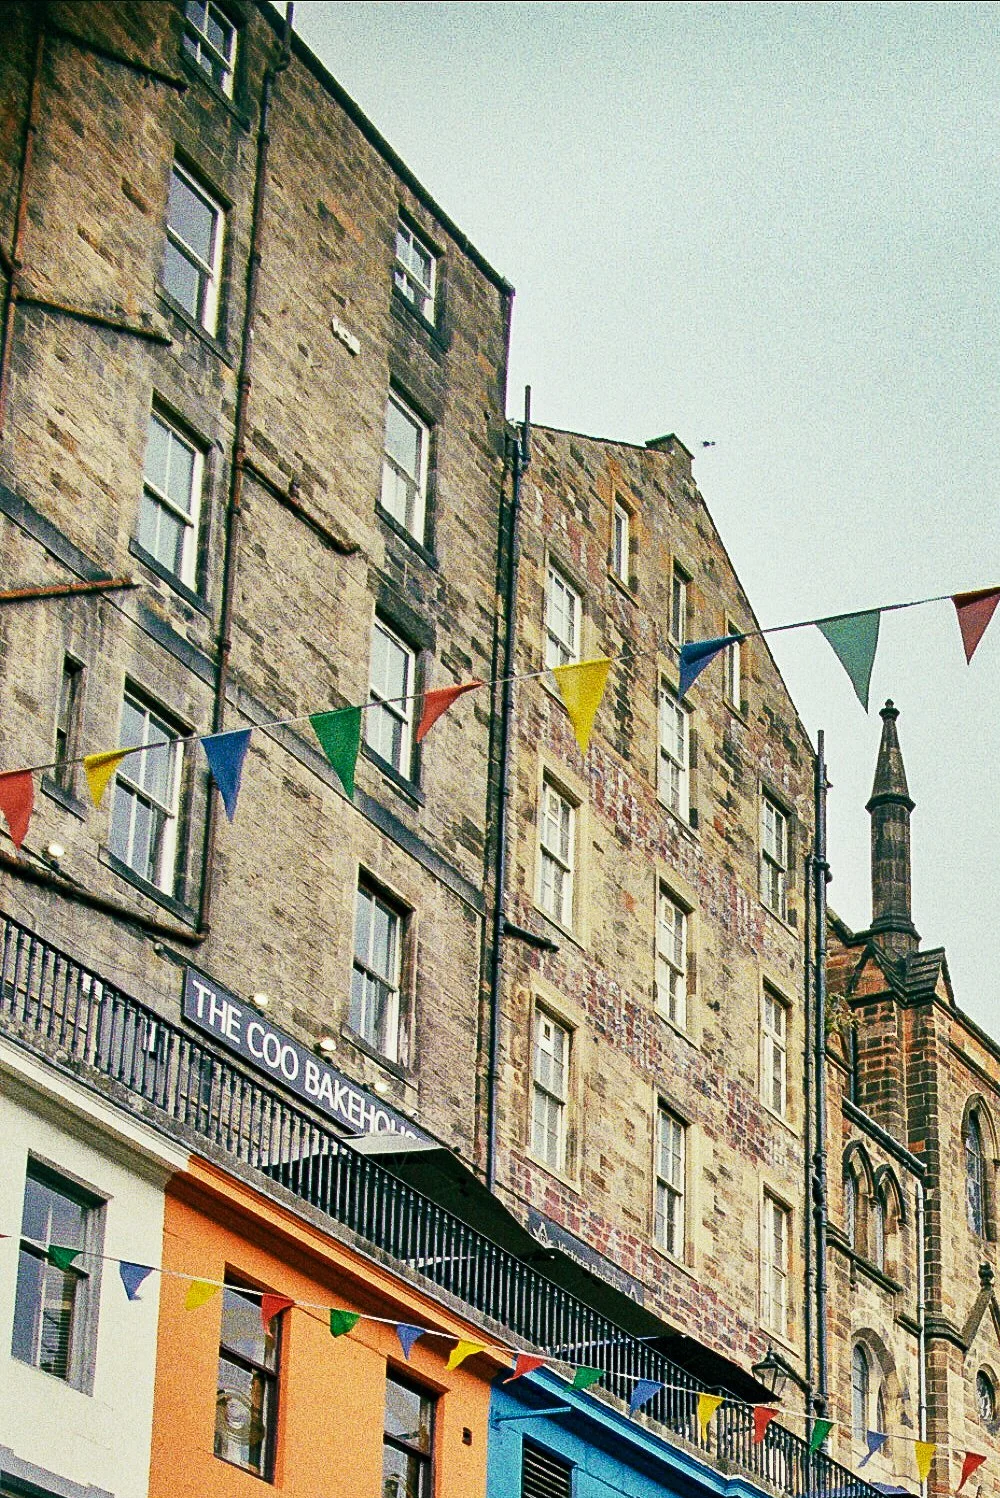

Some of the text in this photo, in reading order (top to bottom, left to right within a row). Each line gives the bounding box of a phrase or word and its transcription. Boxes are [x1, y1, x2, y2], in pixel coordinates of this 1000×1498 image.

[193, 980, 422, 1141] THE COO BAKEHO
